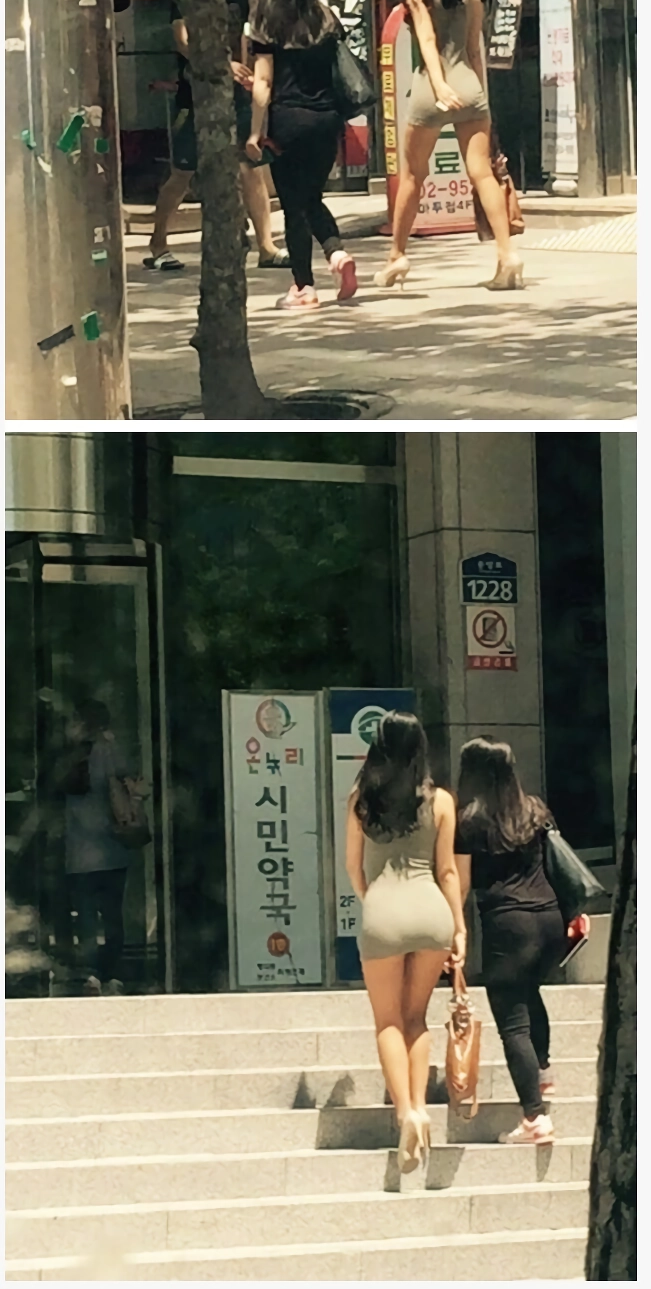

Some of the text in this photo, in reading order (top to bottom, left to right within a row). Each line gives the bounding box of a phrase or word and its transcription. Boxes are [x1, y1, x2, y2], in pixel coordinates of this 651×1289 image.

[467, 579, 513, 601] 1228
[246, 736, 304, 775] 온누리
[255, 785, 297, 926] 시민약국
[339, 895, 356, 908] 2F
[341, 917, 356, 930] 1F
